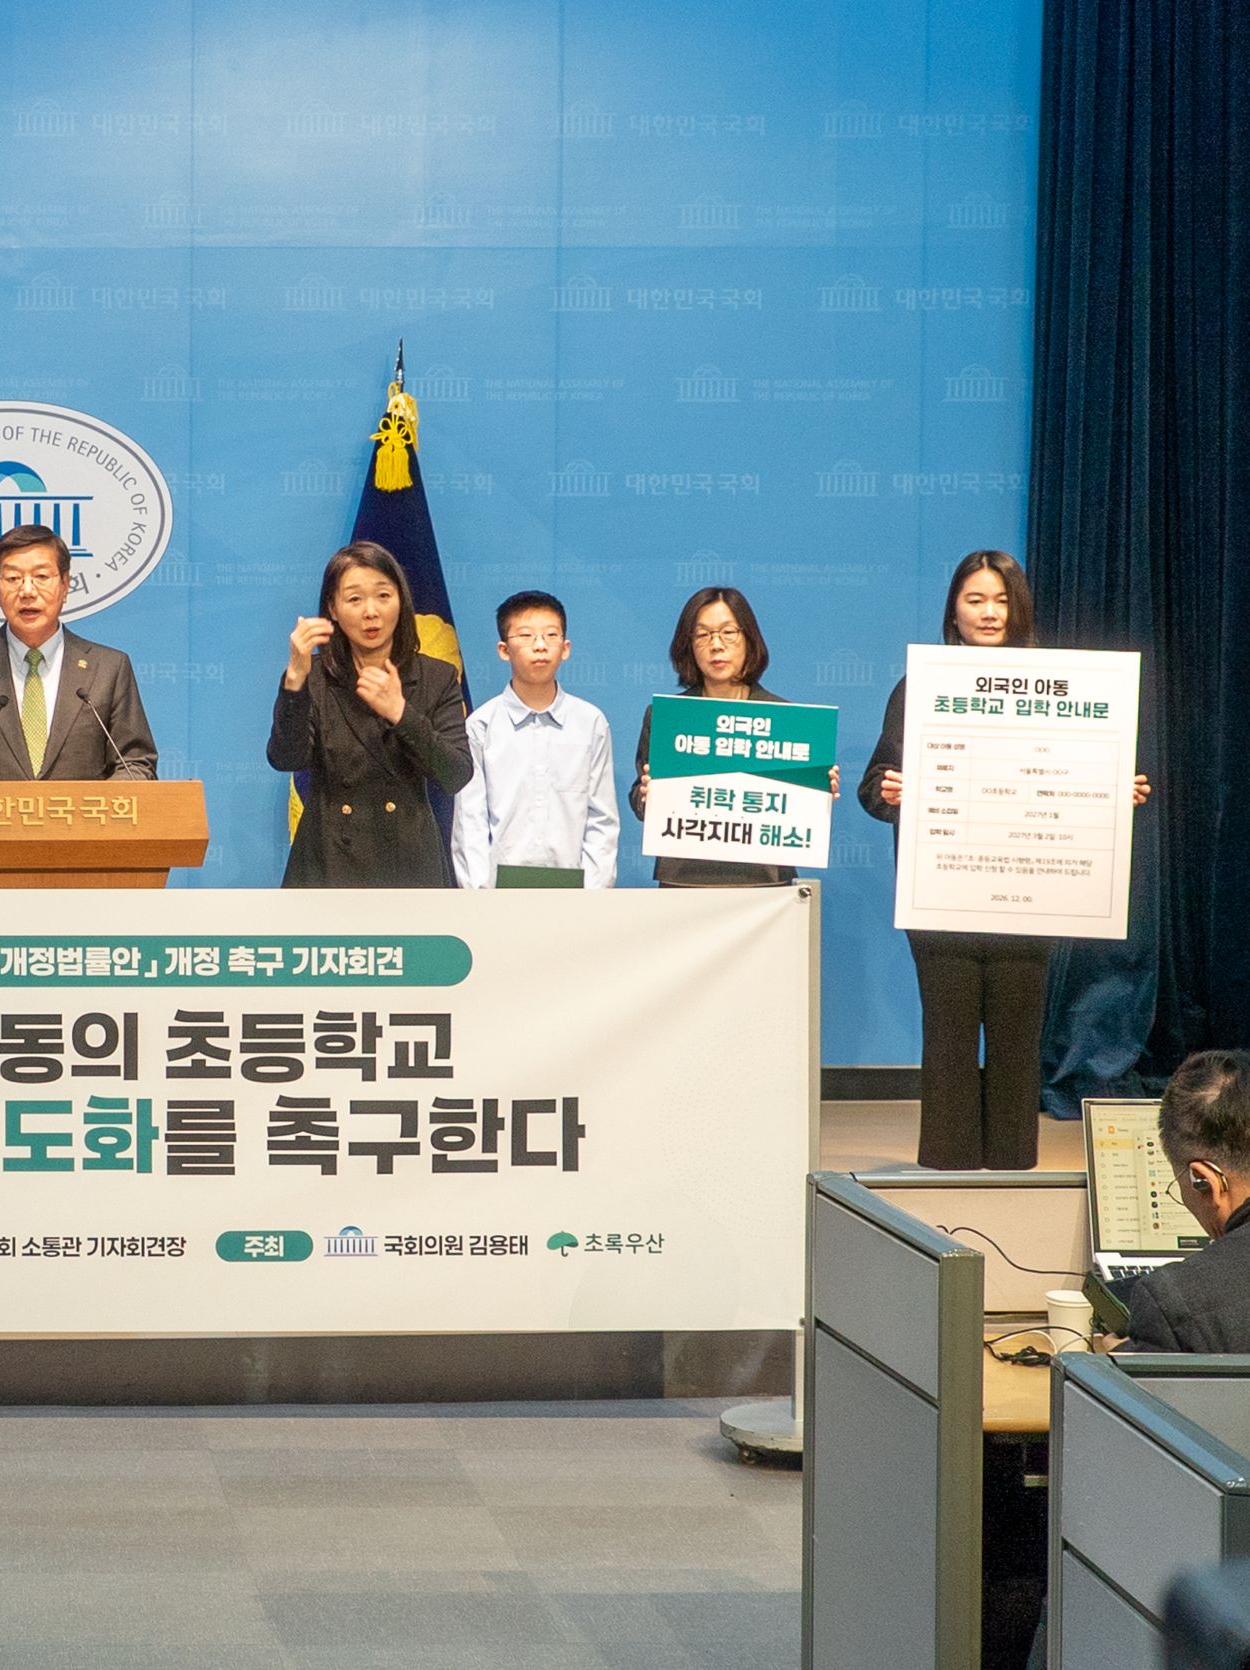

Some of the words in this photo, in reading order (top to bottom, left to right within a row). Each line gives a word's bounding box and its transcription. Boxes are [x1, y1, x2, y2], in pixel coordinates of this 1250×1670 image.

[2, 425, 25, 441] OF
[30, 427, 63, 448] THE
[66, 436, 138, 492] REPUBLIC
[130, 492, 149, 516] OF
[104, 521, 148, 573] KOREA
[975, 676, 1029, 695] 외국인
[1034, 678, 1069, 697] 아동
[934, 695, 1005, 715] 초등학교
[1015, 698, 1050, 717] 입학
[1056, 700, 1110, 719] 안내문
[715, 714, 772, 737] 외국인
[674, 734, 711, 755] 아동
[715, 737, 752, 758] 입학
[755, 740, 810, 762] 안내로
[689, 786, 736, 812] 취학
[741, 791, 787, 814] 통지
[661, 817, 753, 845] 사각지대
[759, 823, 812, 849] 해소!
[165, 947, 219, 976] 개정
[228, 946, 283, 976] 촉구
[293, 947, 403, 975] 기자회견
[166, 1009, 453, 1083] 초등학교
[267, 1095, 585, 1175] 촉구한다
[22, 1237, 82, 1257] 소통관
[87, 1237, 186, 1257] 기자회견장
[243, 1234, 285, 1258] 주최
[384, 1236, 463, 1256] 국회의원
[470, 1235, 528, 1255] 김용태
[584, 1234, 664, 1254] 초록우산
